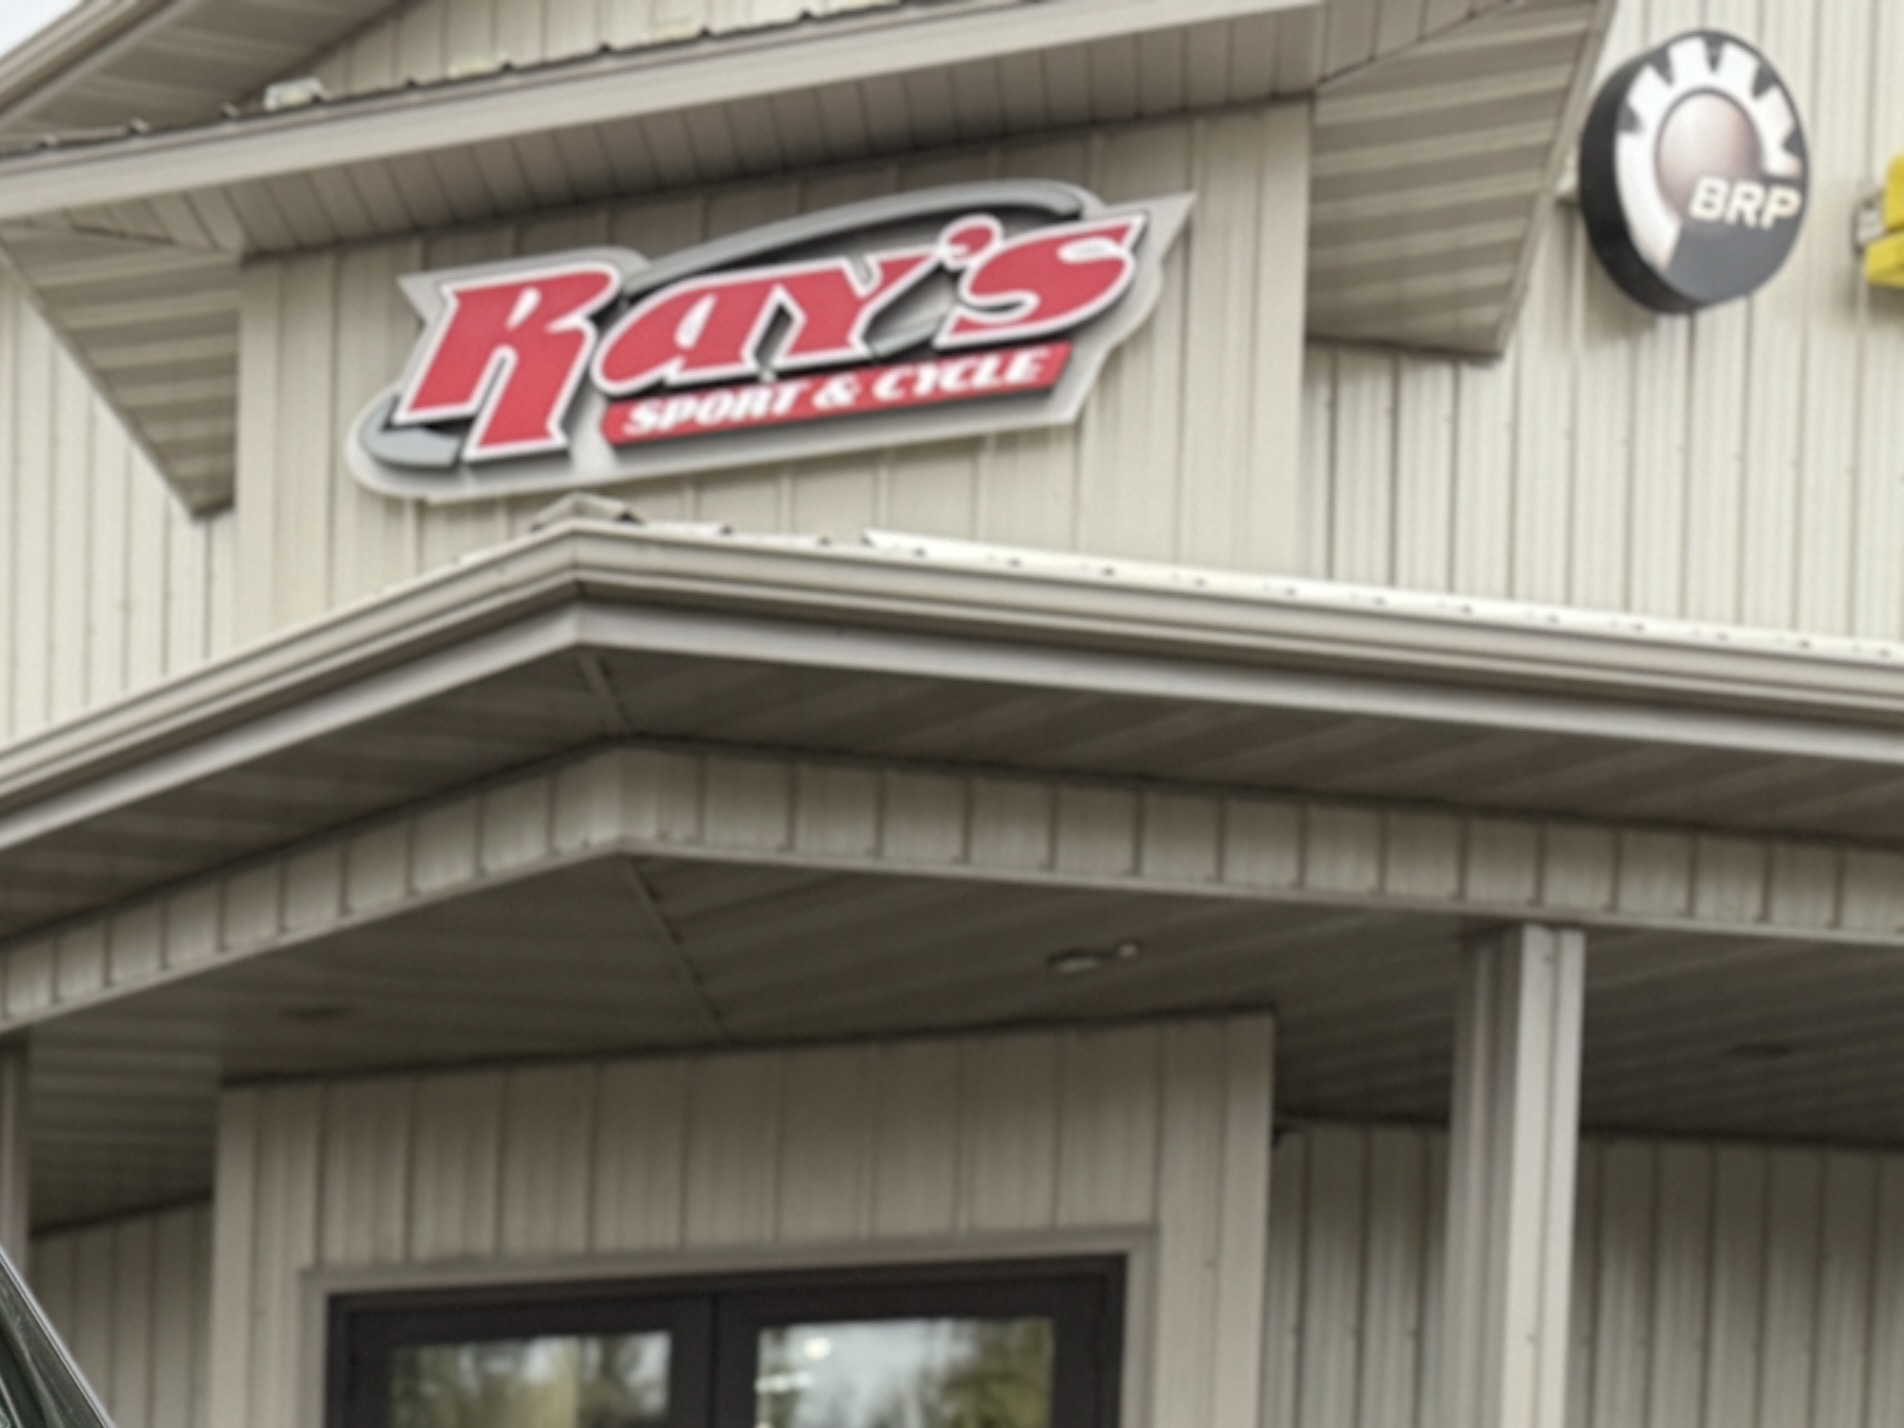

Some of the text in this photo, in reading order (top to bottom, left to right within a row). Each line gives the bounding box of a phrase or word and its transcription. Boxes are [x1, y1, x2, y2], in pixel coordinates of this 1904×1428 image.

[1690, 175, 1801, 230] BRP
[622, 348, 1050, 437] SPORT & CYCLE
